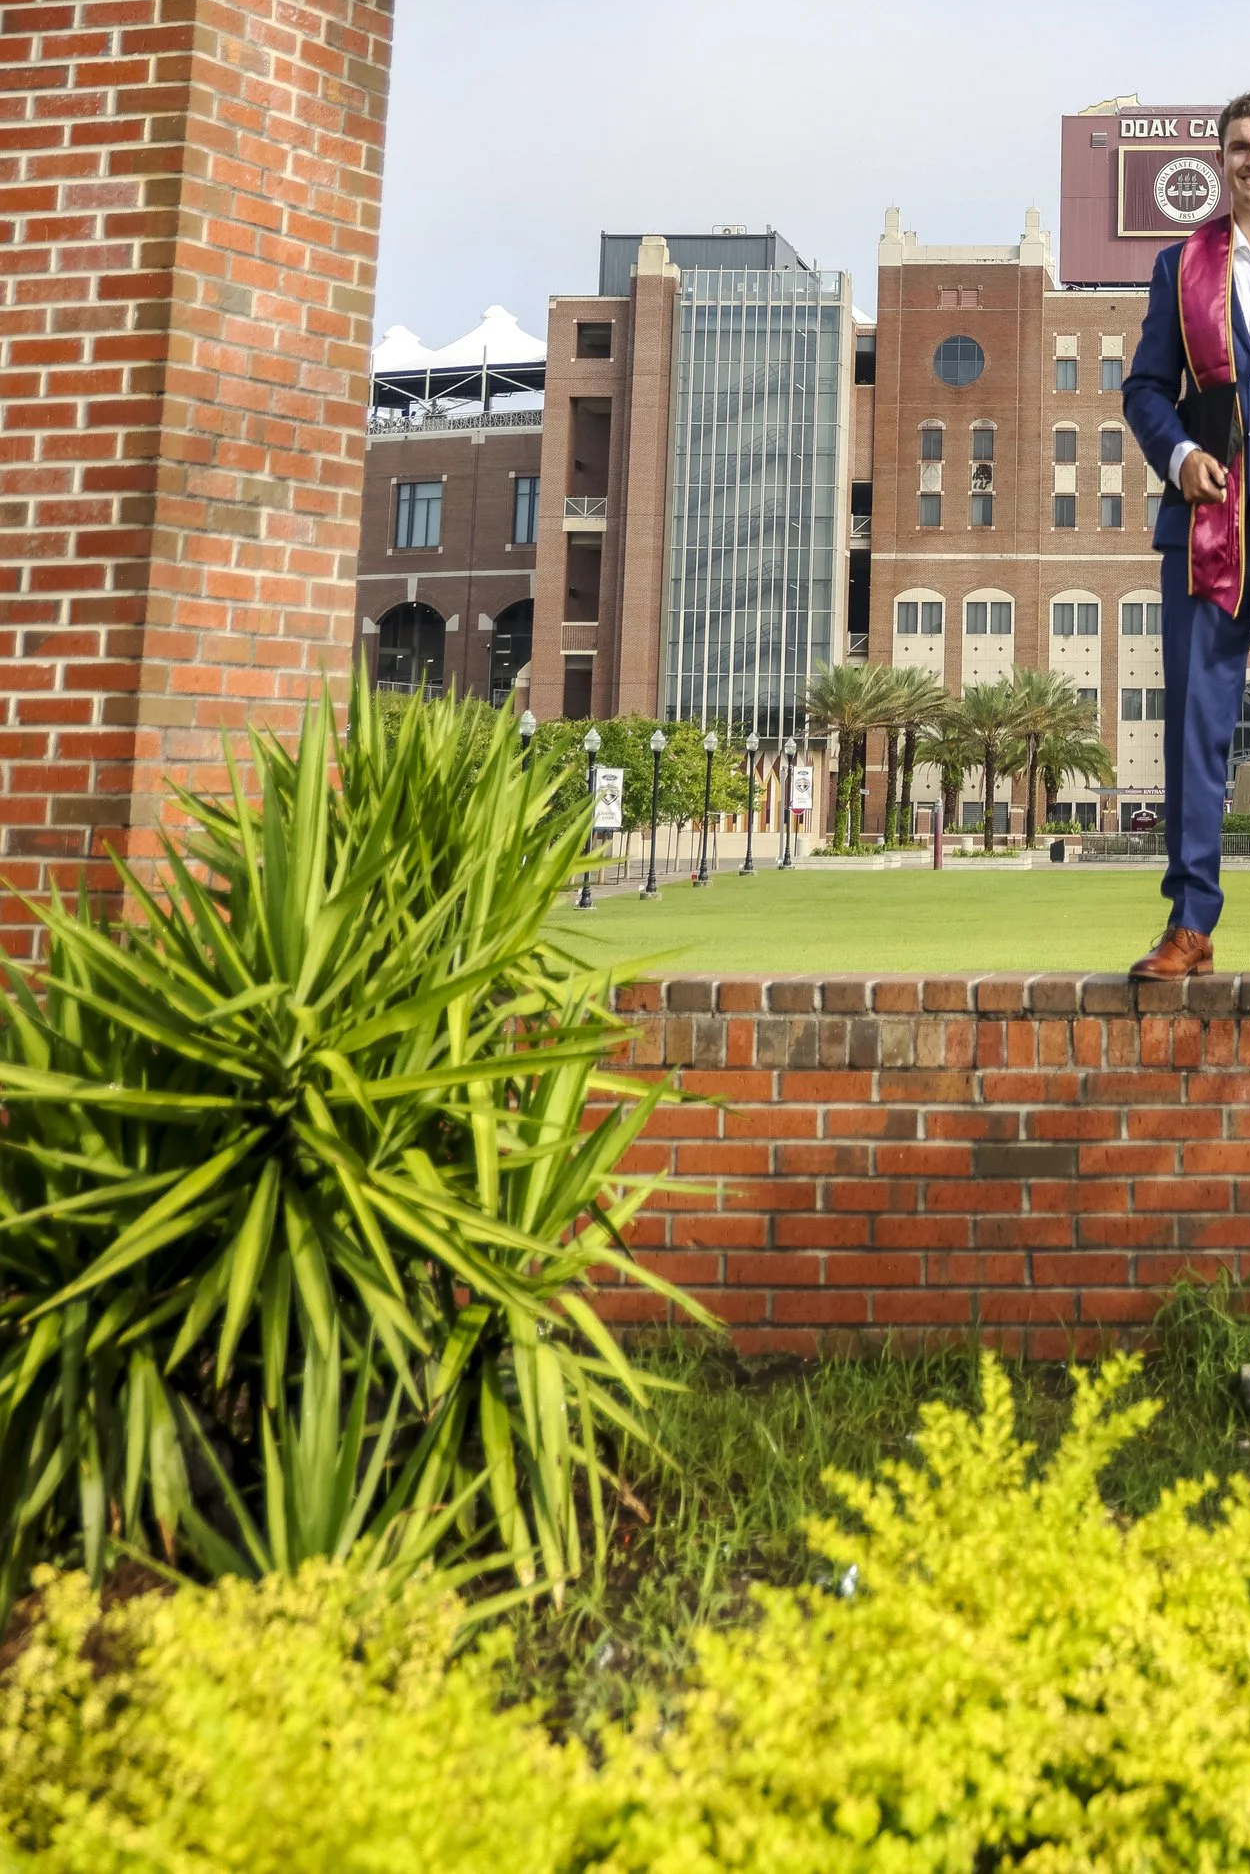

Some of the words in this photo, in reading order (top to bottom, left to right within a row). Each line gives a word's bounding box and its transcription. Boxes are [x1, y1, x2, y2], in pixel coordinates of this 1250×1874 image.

[1120, 119, 1179, 137] DOAK
[1157, 172, 1169, 207] FLORIDA
[1169, 161, 1193, 173] STATE
[1195, 162, 1217, 208] UNIVERSITY
